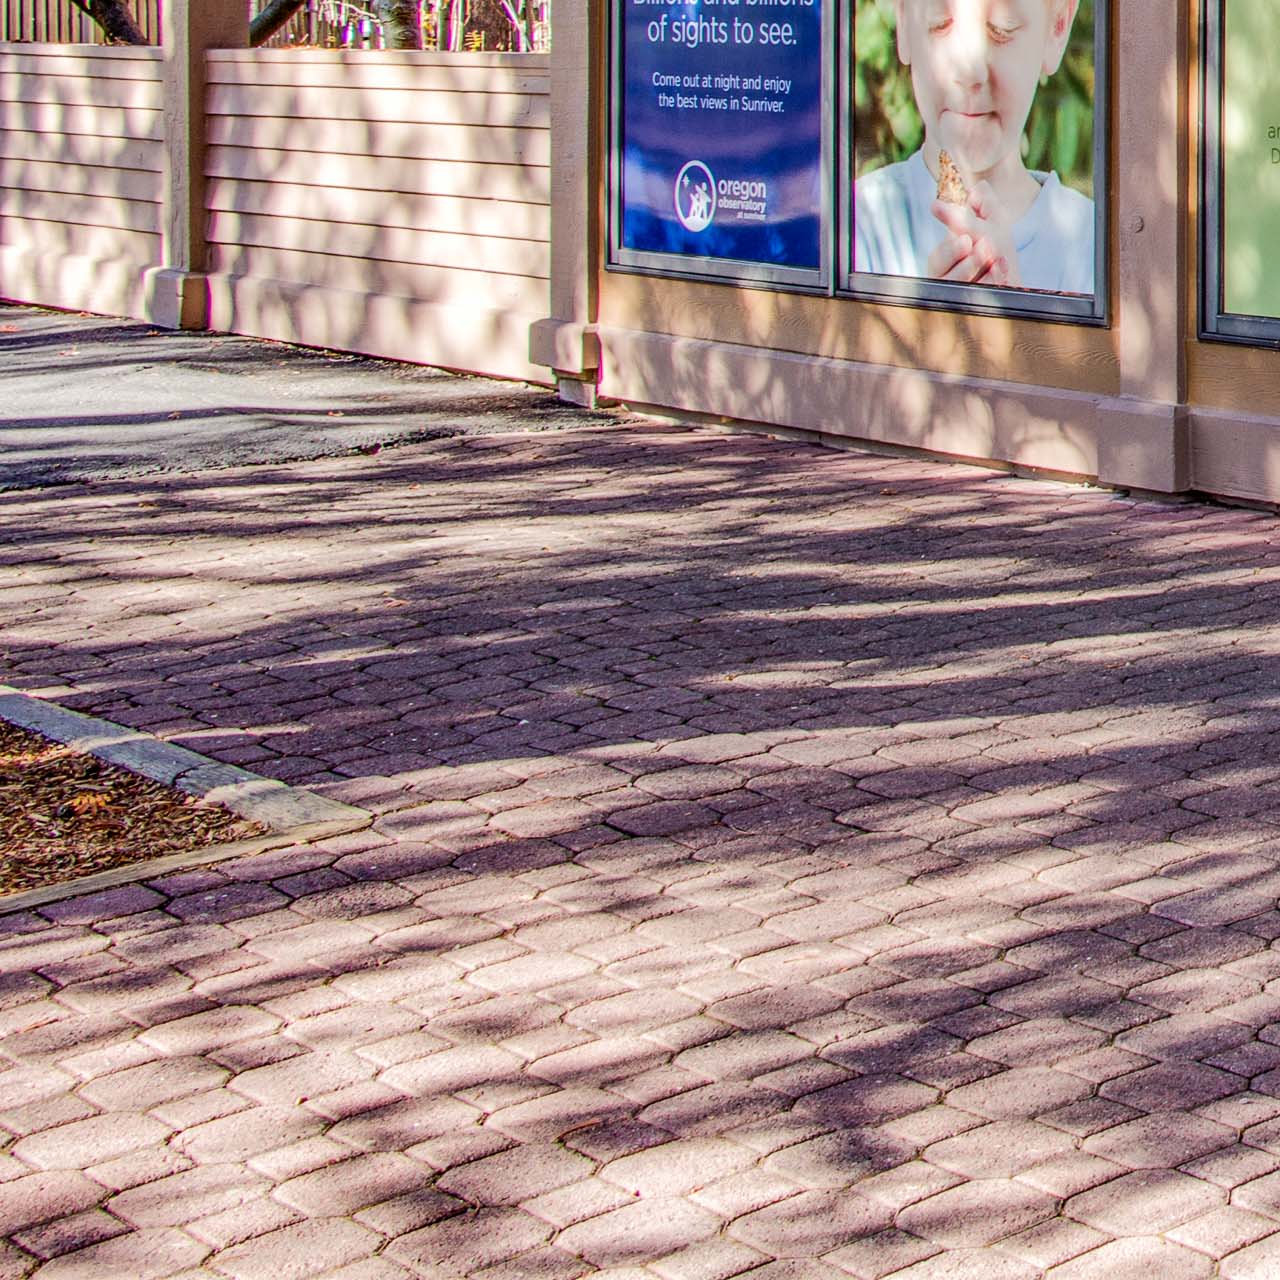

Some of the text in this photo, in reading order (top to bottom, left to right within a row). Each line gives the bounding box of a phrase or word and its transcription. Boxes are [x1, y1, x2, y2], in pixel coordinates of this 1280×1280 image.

[648, 14, 797, 48] of sights to see.
[652, 72, 791, 94] Come out at night and enjoy
[659, 93, 784, 113] the best views in Sunriver.
[718, 180, 766, 200] oregon
